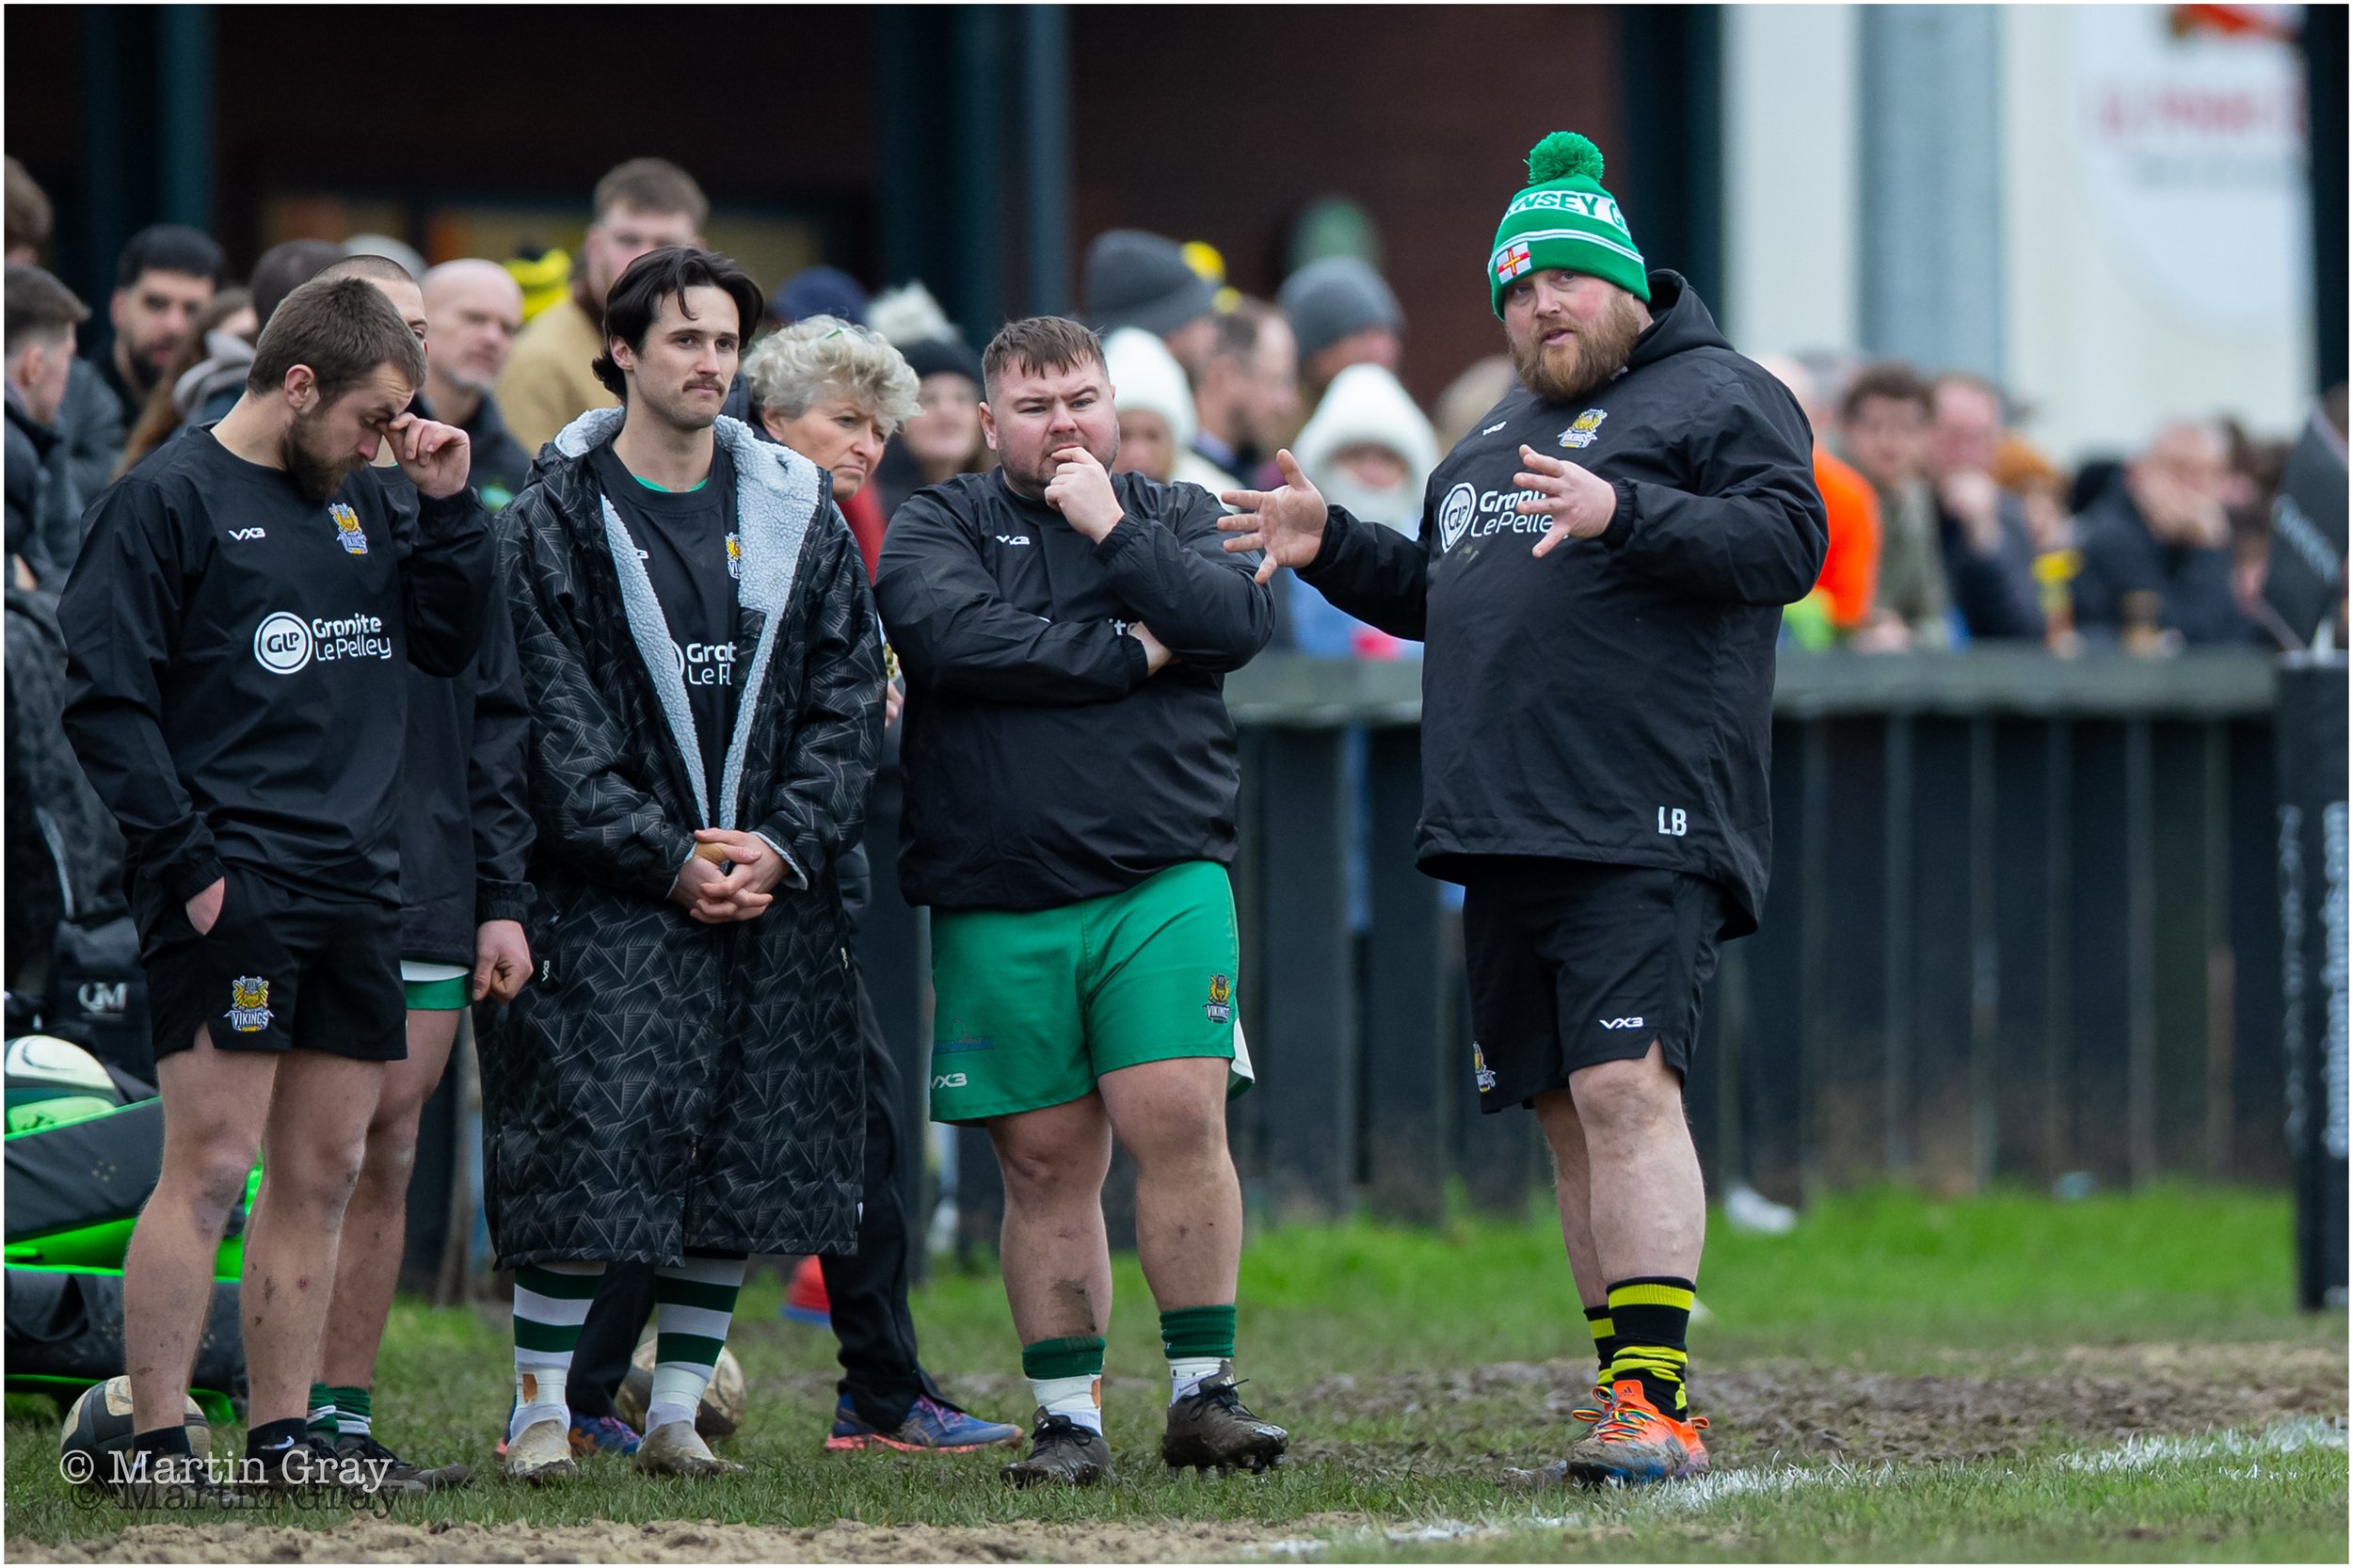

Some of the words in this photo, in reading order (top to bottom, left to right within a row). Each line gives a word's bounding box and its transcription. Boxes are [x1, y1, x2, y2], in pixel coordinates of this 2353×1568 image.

[1507, 192, 1598, 216] NSEY
[228, 527, 265, 540] VX3
[312, 612, 382, 638] Granite
[266, 632, 300, 653] GLP
[1657, 806, 1687, 836] LB
[232, 1011, 268, 1027] VIKINGS
[1599, 1016, 1644, 1030] VX3
